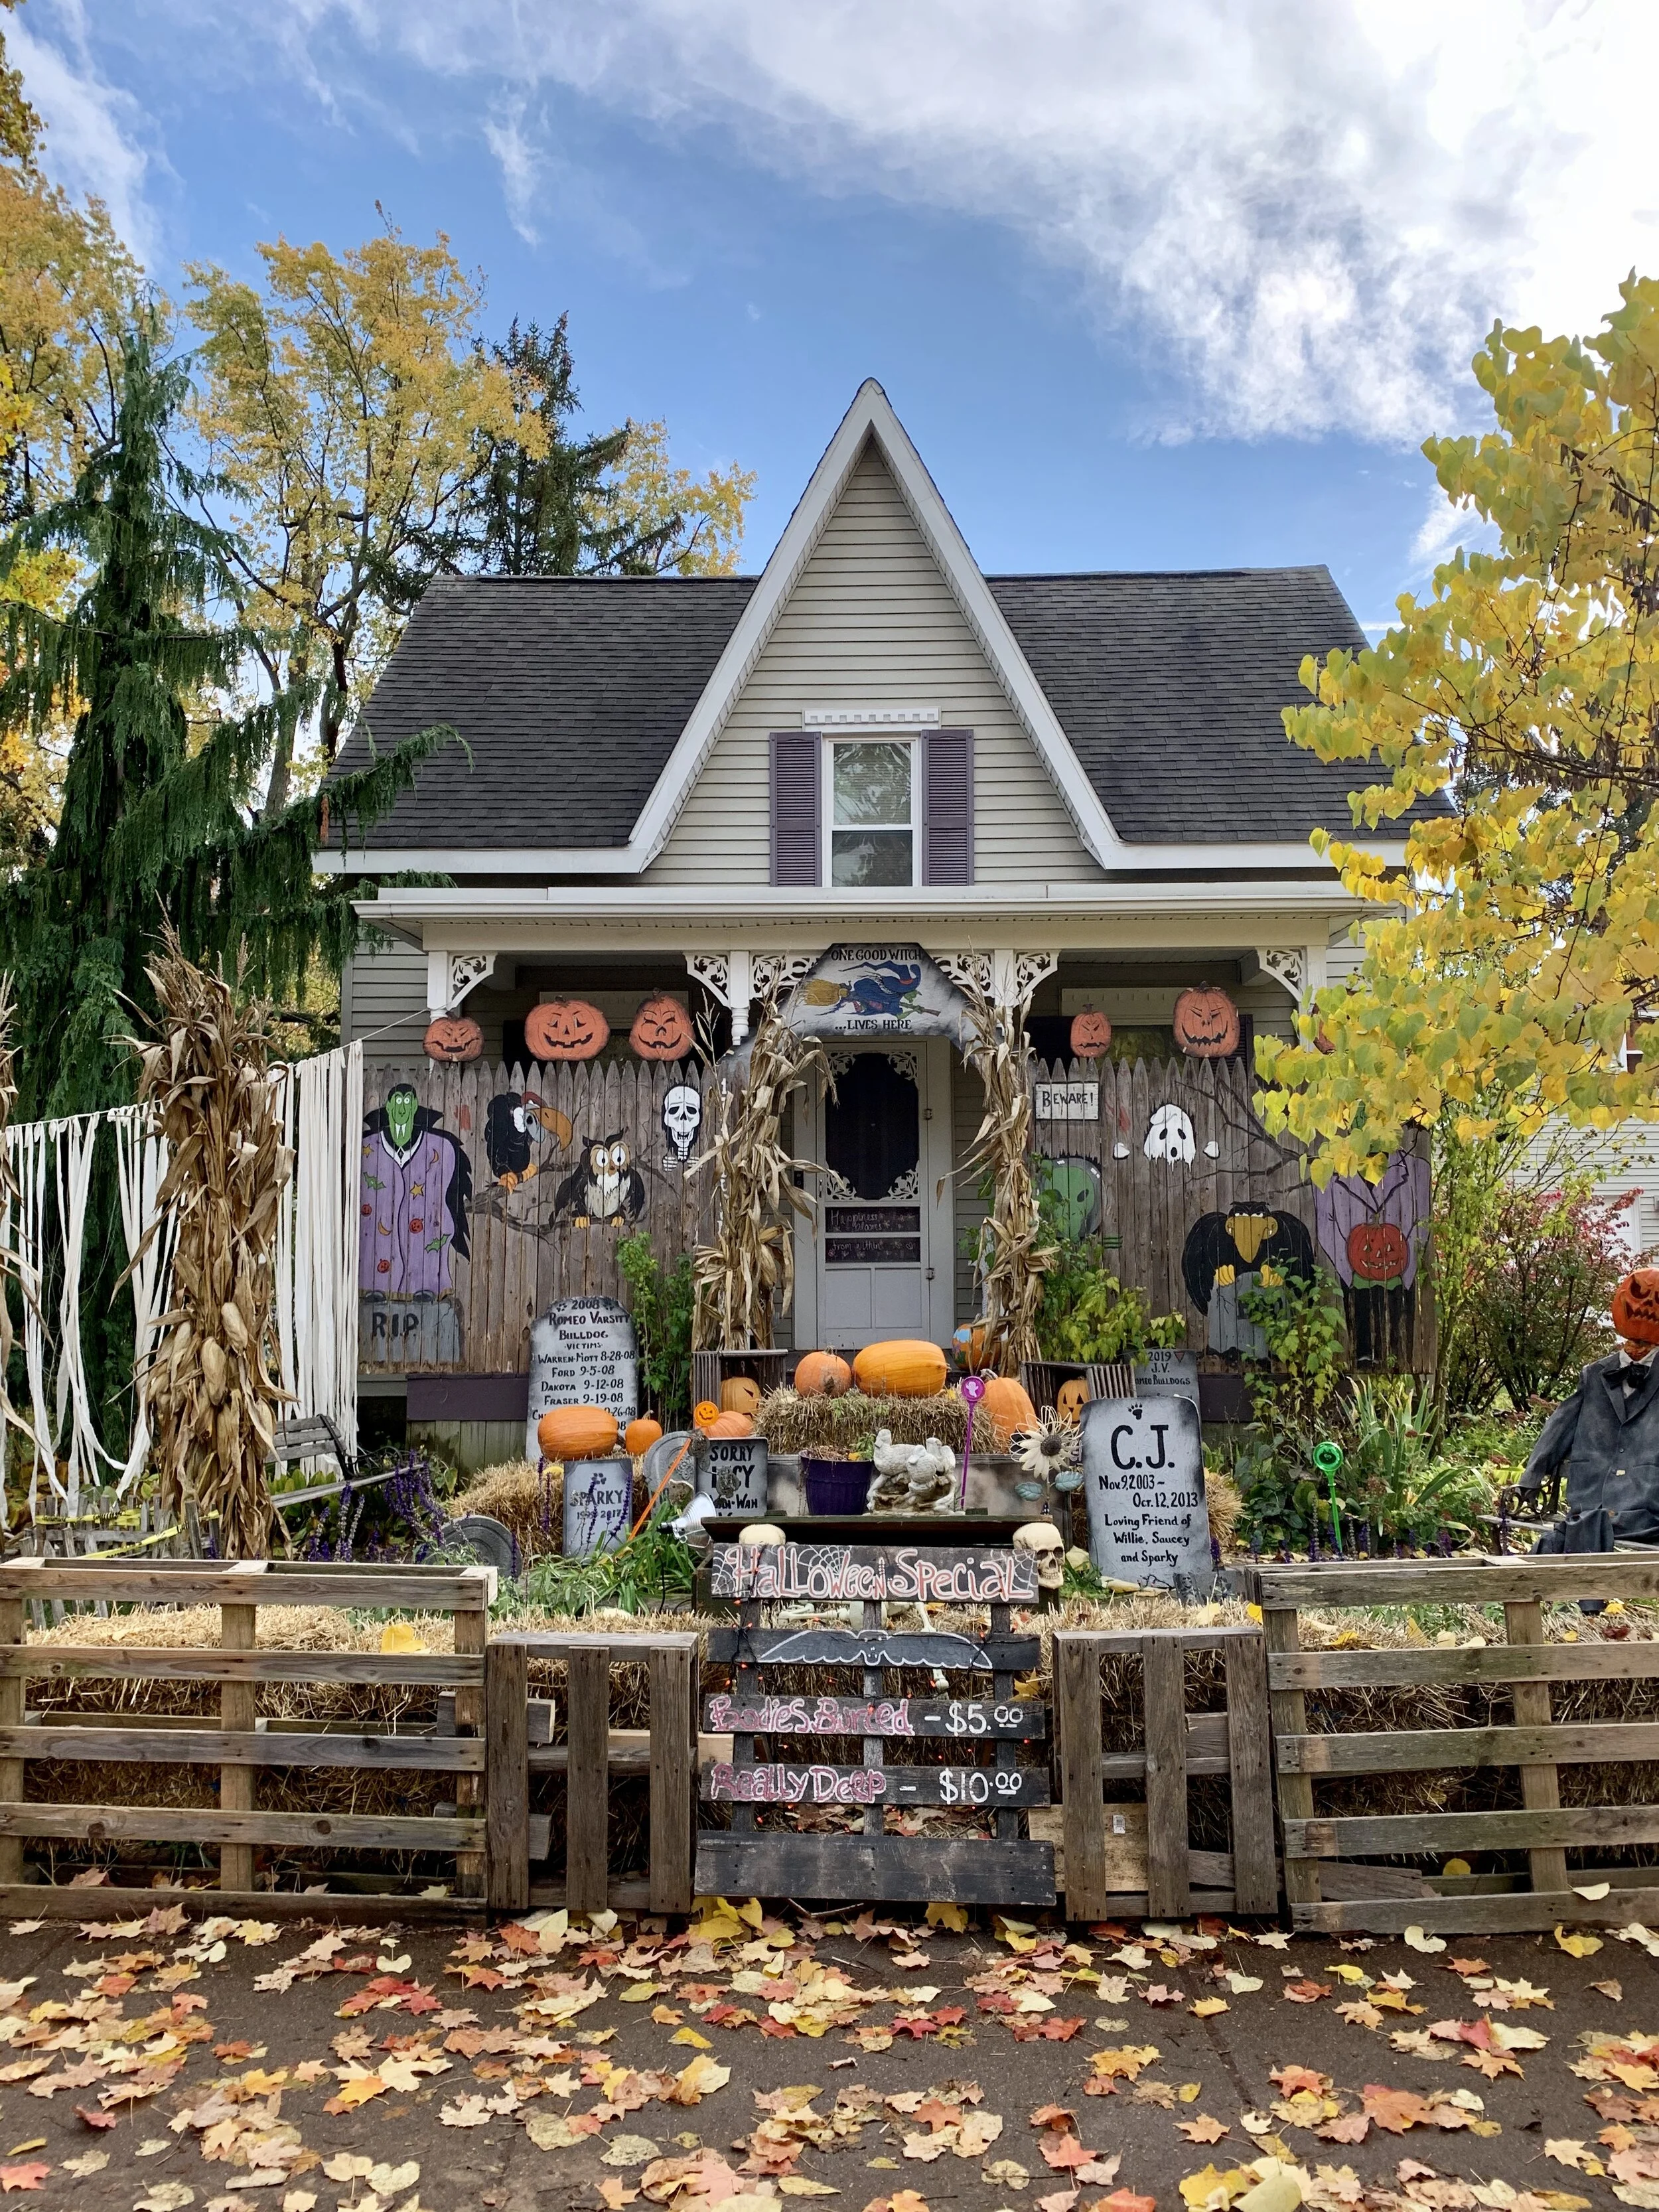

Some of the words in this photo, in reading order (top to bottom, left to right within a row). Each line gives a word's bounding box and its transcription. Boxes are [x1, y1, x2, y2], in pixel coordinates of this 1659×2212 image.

[831, 949, 853, 961] ONE
[855, 949, 887, 960] GOOD
[889, 949, 921, 960] WITCH
[883, 1019, 911, 1029] HERE
[571, 1299, 600, 1310] 2008
[1148, 1351, 1171, 1362] 2019
[1151, 1363, 1170, 1373] J.V.
[709, 1445, 755, 1461] SORRY
[1111, 1425, 1175, 1470] C.J.
[1104, 1514, 1139, 1530] Loving
[1141, 1514, 1179, 1526] Friend
[1181, 1514, 1191, 1528] of
[1152, 1531, 1190, 1547] Saucey
[1121, 1552, 1139, 1562] and
[1141, 1550, 1179, 1567] Sparky
